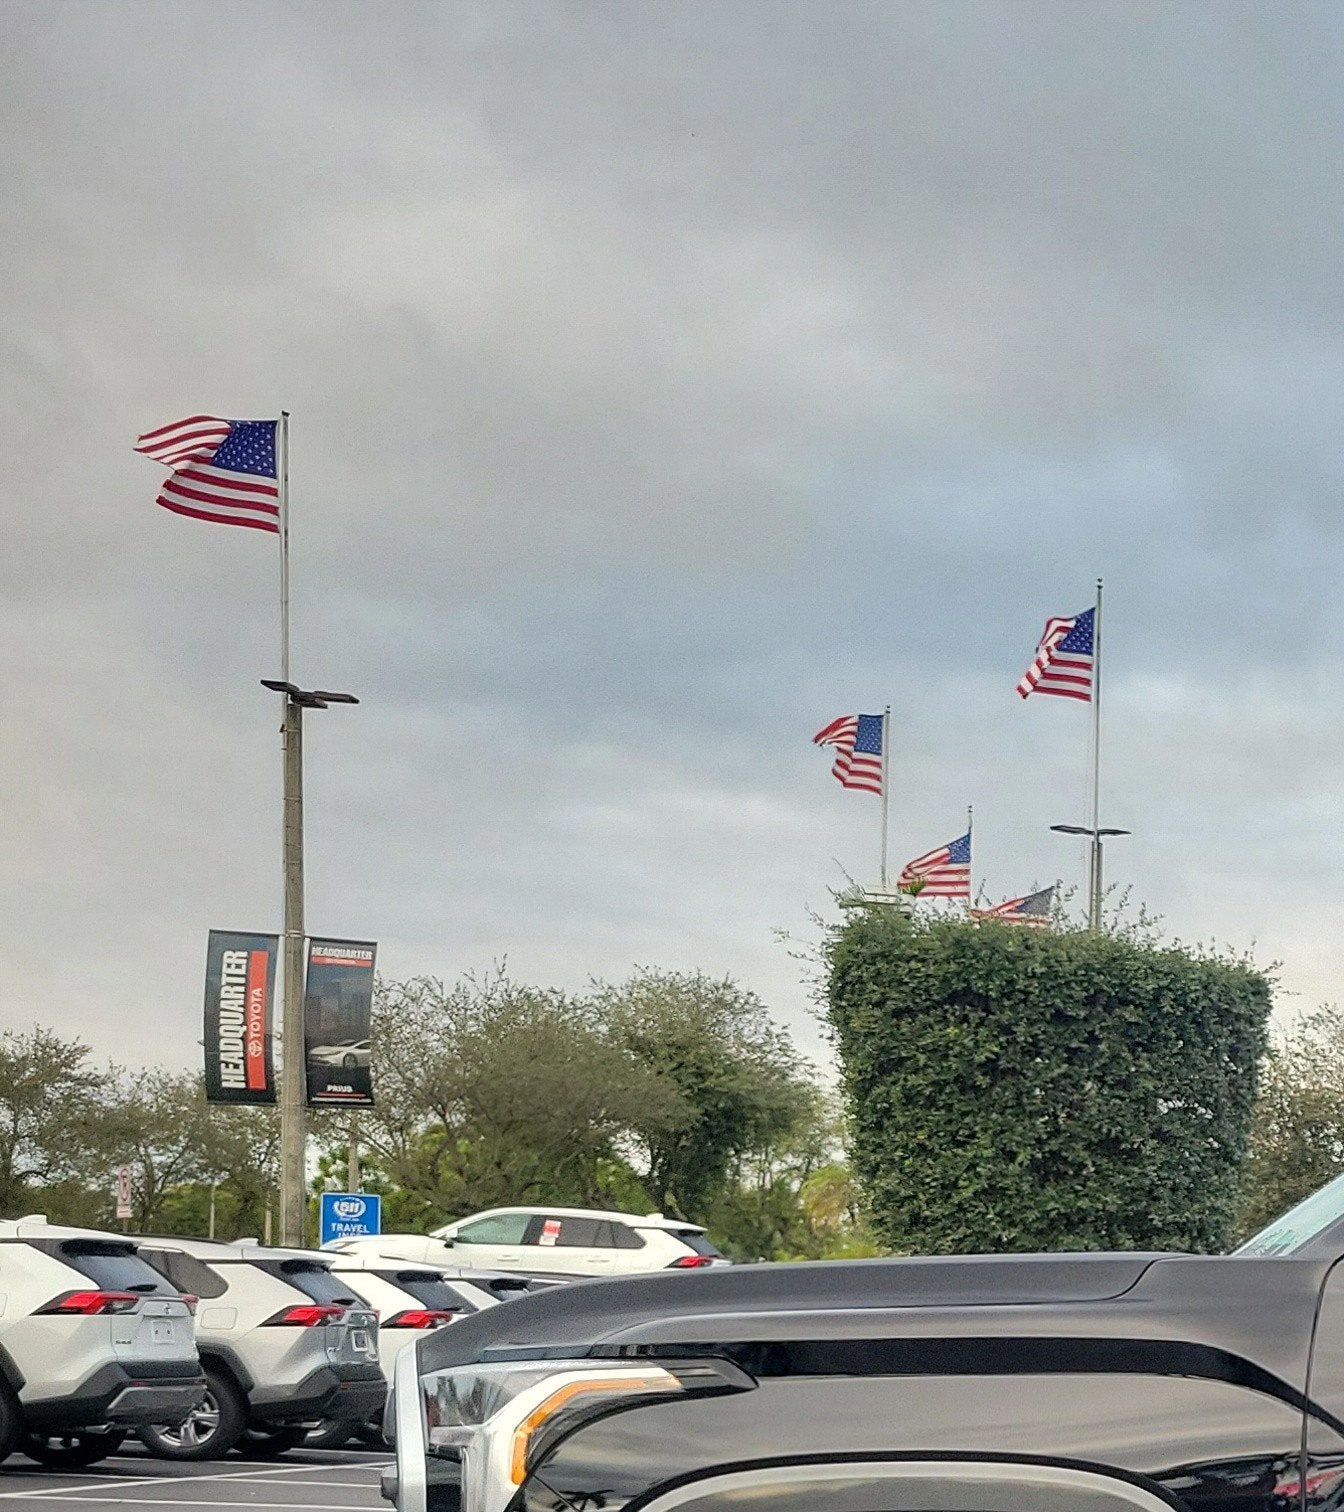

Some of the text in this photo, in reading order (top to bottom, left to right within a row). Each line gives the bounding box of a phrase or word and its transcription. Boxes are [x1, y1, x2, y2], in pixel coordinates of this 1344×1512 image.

[312, 946, 373, 960] HEADQUARTER
[219, 949, 248, 1089] HEADQUARTER
[251, 987, 263, 1040] TOYOTA
[331, 1222, 368, 1233] TRAVEL
